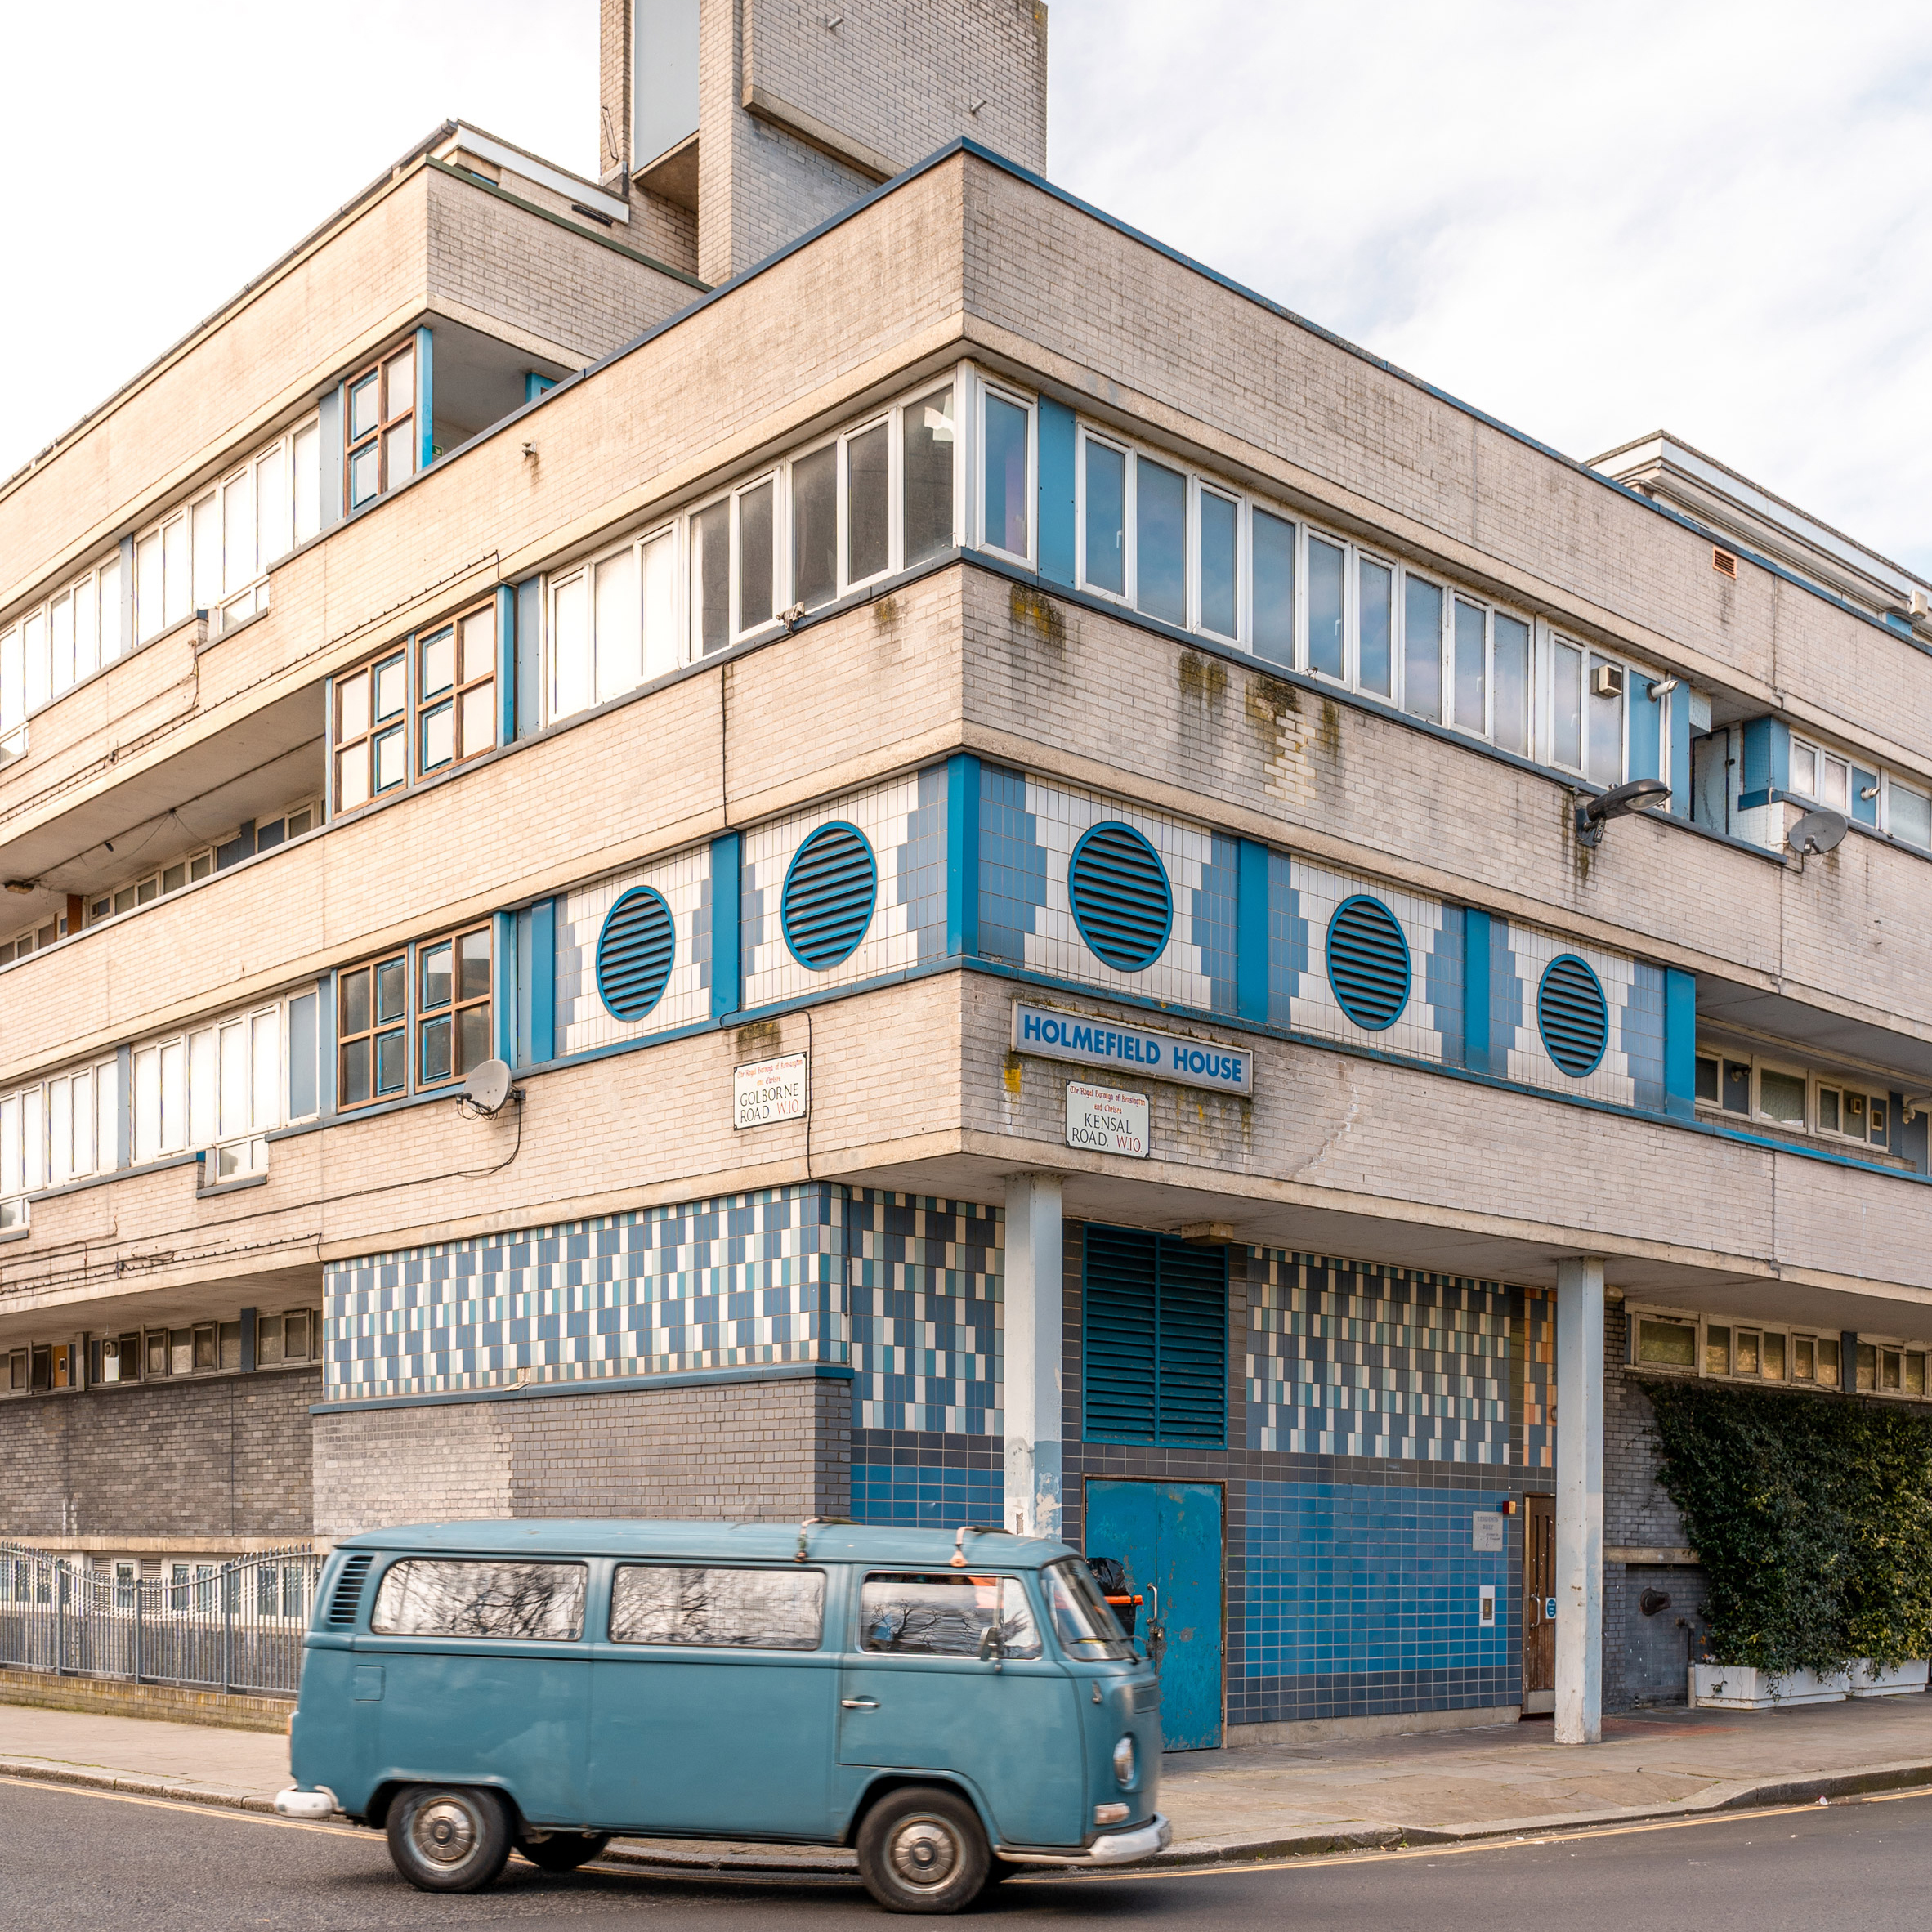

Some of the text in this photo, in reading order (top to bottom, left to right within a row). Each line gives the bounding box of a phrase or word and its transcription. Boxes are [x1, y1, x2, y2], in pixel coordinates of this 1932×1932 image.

[1024, 1014, 1242, 1083] HOLMEFIELD HOUSE
[758, 1065, 773, 1073] Borough
[781, 1059, 803, 1068] Kensington
[740, 1083, 798, 1107] GOLBORNE
[1080, 1087, 1093, 1098] Royal
[1095, 1090, 1113, 1102] Borough
[1122, 1094, 1145, 1107] Kensington
[1104, 1104, 1122, 1115] Chelsea
[1085, 1113, 1132, 1134] KENSAL
